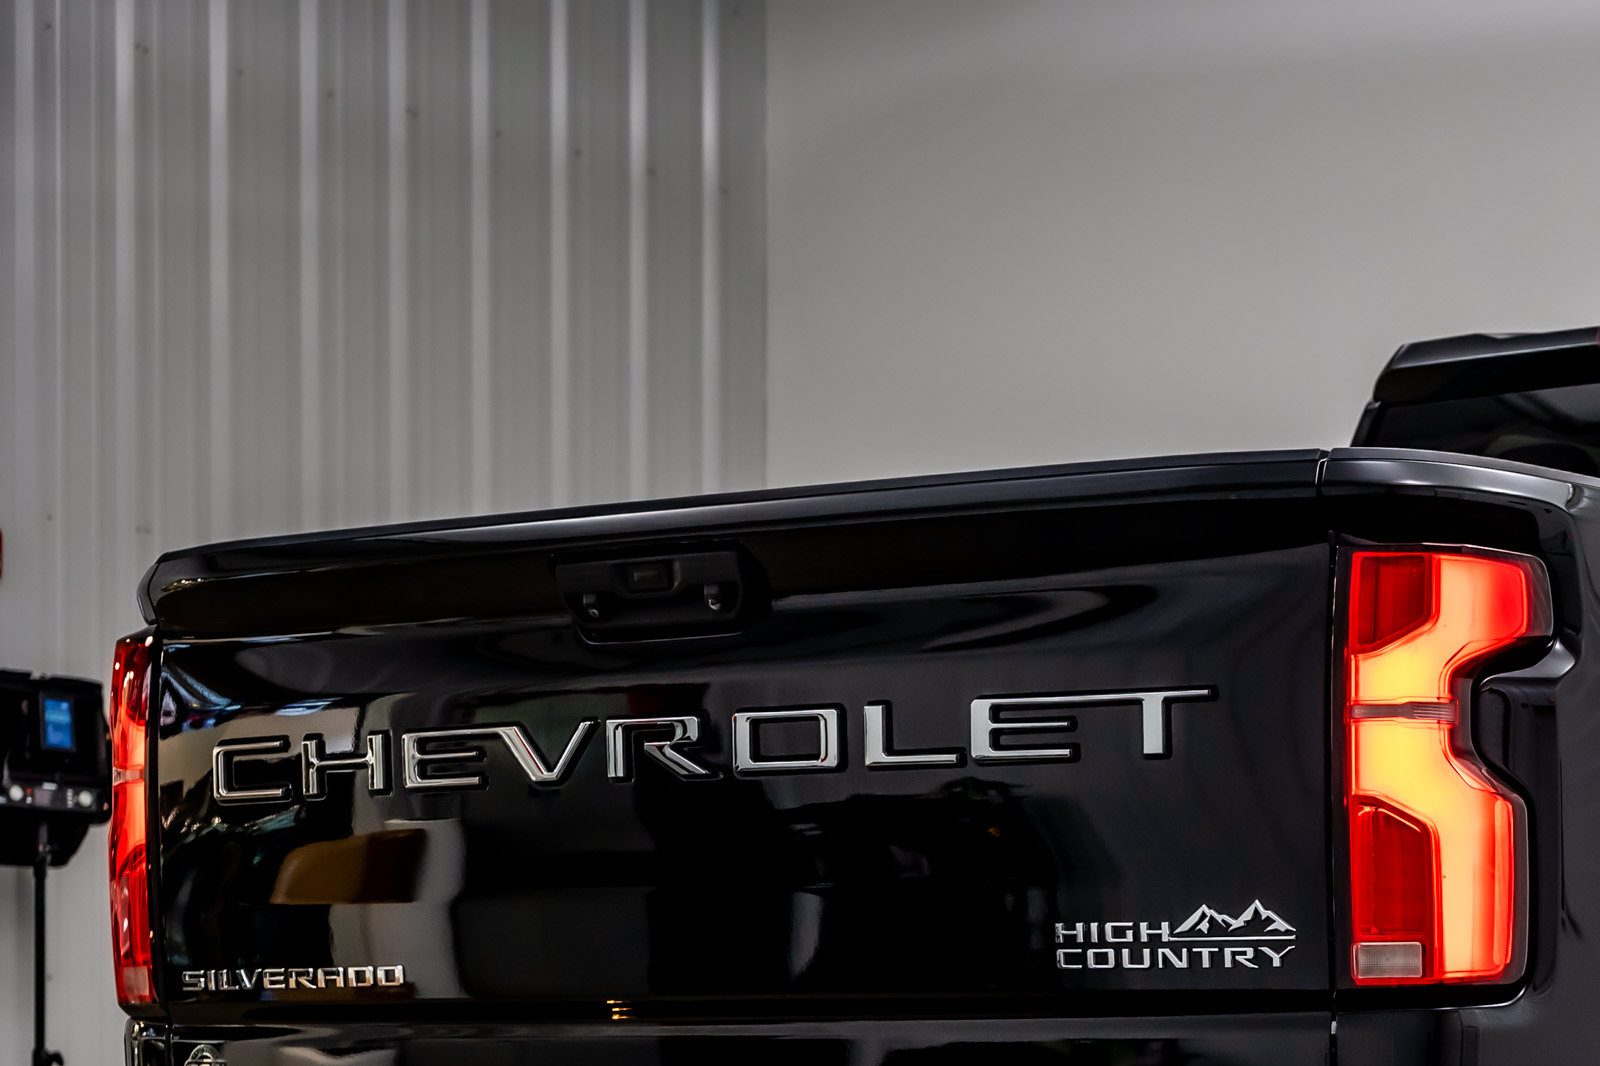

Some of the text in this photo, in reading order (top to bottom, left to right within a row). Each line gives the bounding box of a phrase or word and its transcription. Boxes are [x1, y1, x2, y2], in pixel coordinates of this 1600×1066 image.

[212, 686, 1213, 800] CHEVROLET
[1054, 920, 1171, 944] HIGH
[1054, 945, 1296, 970] COUNTRY
[181, 964, 405, 992] SILVERADO
